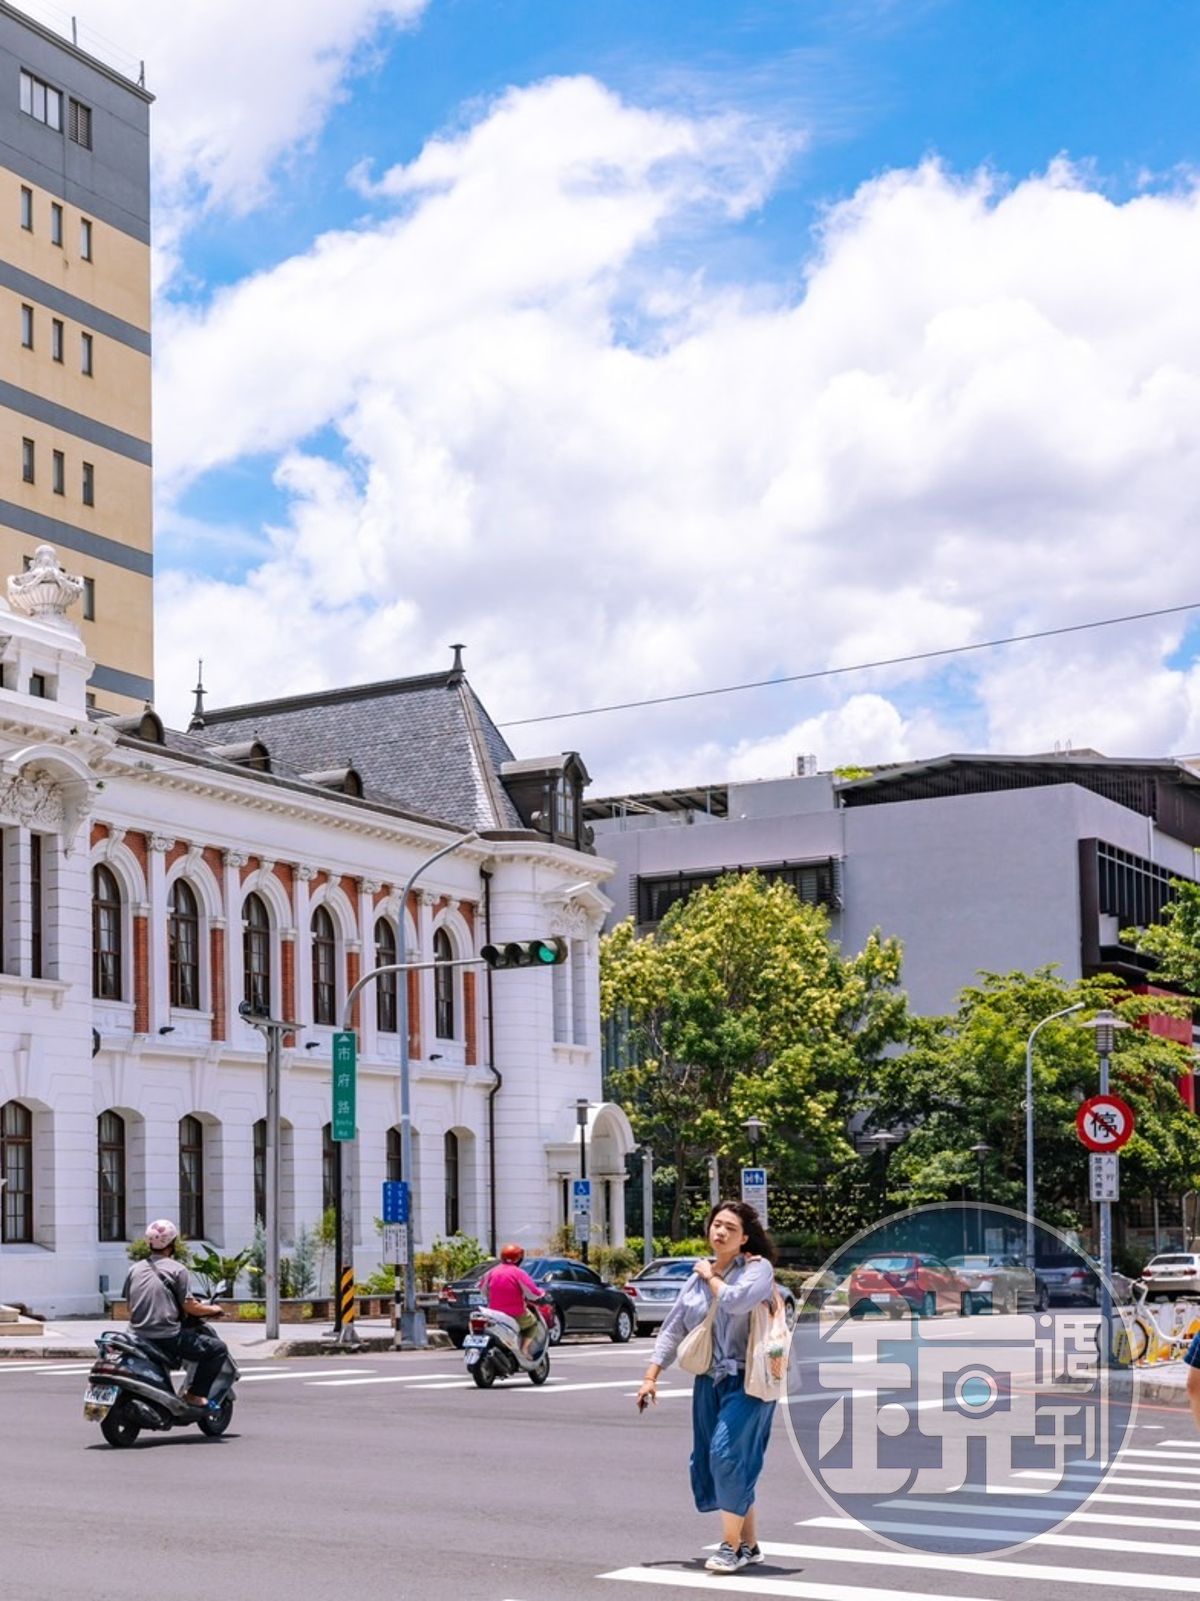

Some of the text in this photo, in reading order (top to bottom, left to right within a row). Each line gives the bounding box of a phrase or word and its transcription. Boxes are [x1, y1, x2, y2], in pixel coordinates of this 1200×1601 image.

[337, 1046, 351, 1114] 市府路
[1090, 1111, 1117, 1138] 停
